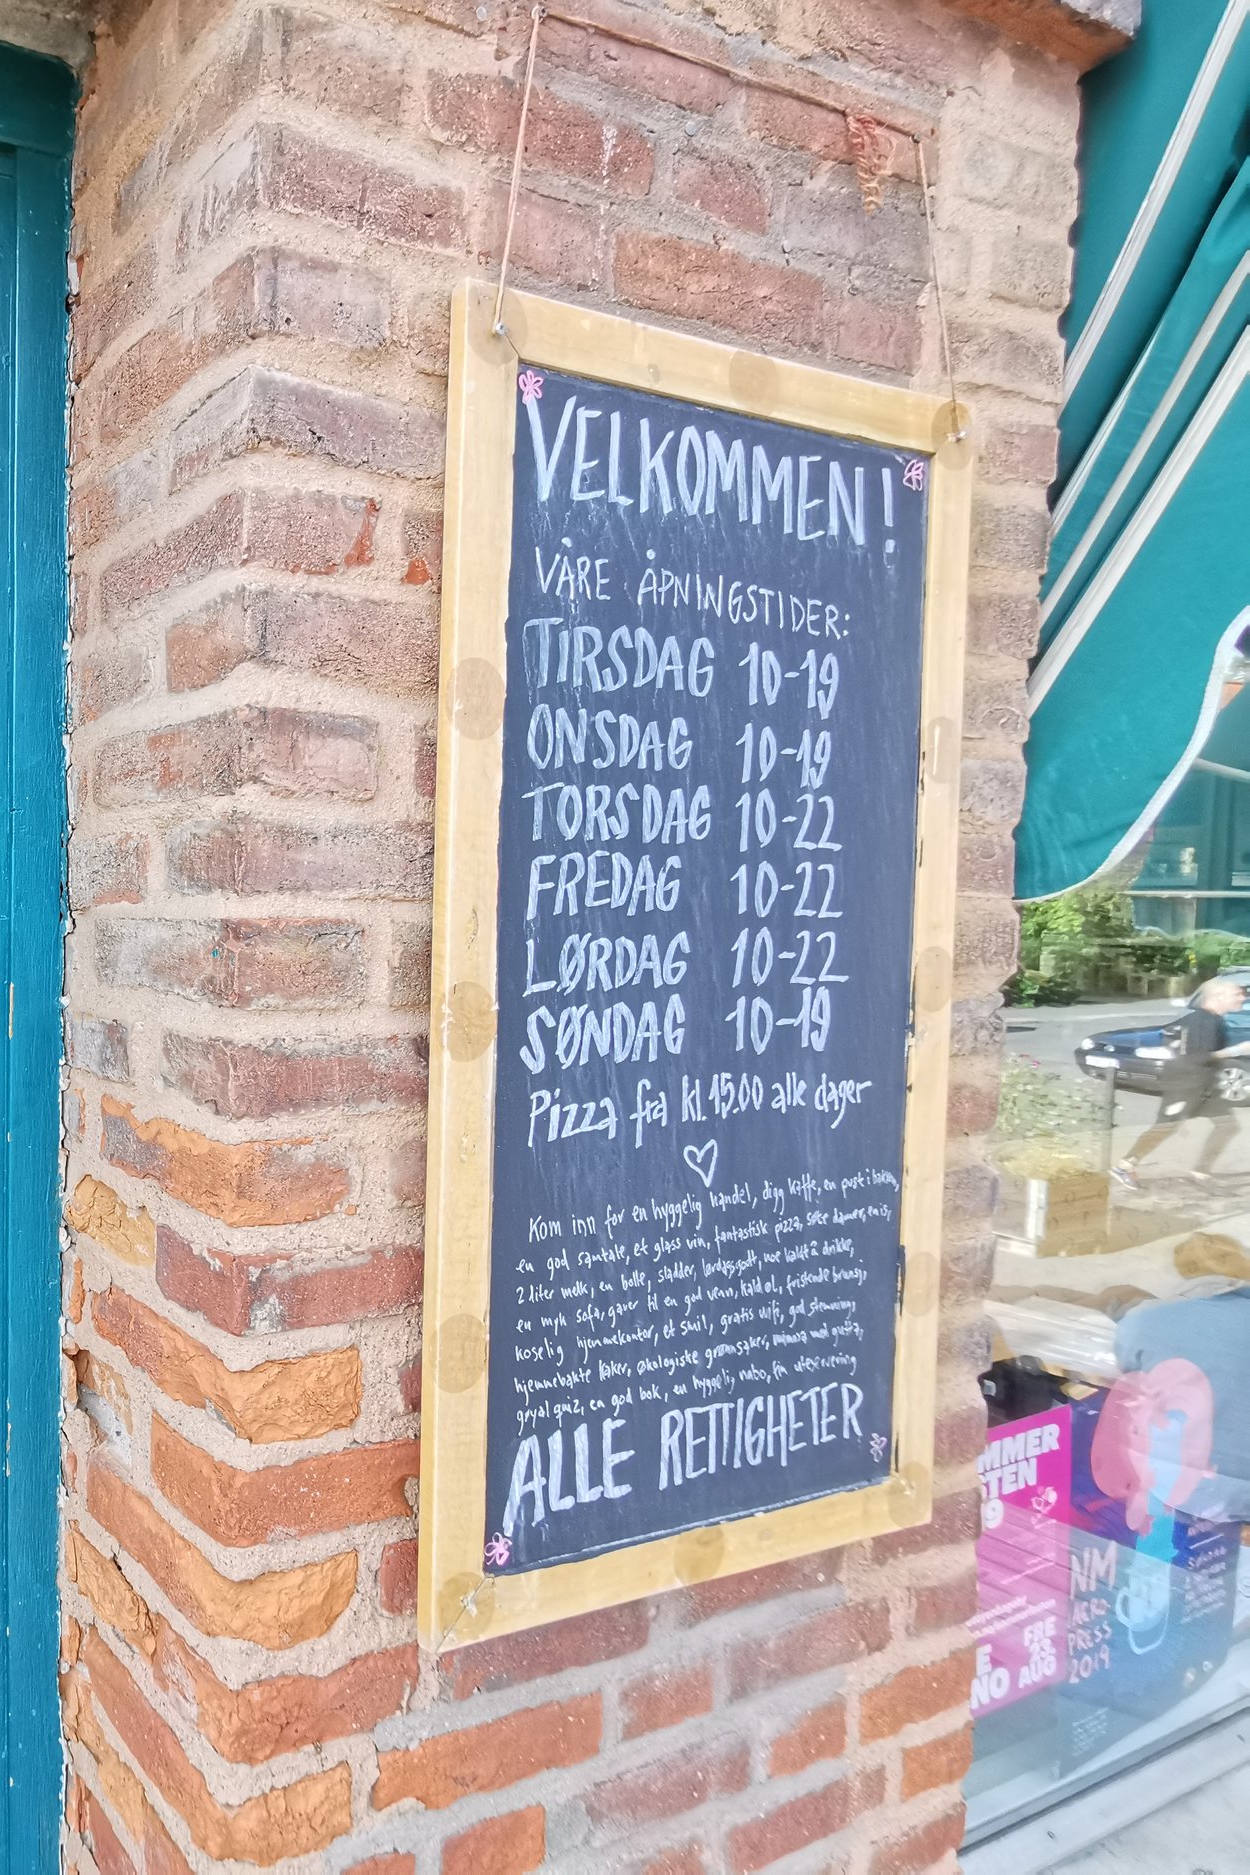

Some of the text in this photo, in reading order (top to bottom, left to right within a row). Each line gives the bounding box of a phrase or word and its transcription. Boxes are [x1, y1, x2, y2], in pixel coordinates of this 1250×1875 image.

[535, 537, 851, 640] VÅRE ÅPNINGSTIDER:
[524, 618, 840, 720] TIRSDAG 10-19
[527, 703, 831, 789] ONSDAG 10-19
[522, 782, 842, 852] TORSDAG 10-22
[527, 850, 843, 921] FREDAG 10-22
[523, 926, 849, 997] LØRDAG 10-22
[519, 986, 831, 1074] SØNDAG 10-19
[528, 1090, 618, 1147] Pizza
[629, 1079, 668, 1149] fra
[771, 1072, 806, 1113] alle
[814, 1073, 872, 1129] dager
[529, 1215, 561, 1243] Kom
[572, 1214, 596, 1237] inn
[605, 1204, 625, 1240] for
[632, 1205, 648, 1222] en
[651, 1192, 702, 1232] hyggelig
[762, 1180, 785, 1215] digg
[516, 1259, 534, 1273] en
[547, 1248, 570, 1281] god
[634, 1238, 648, 1257] et
[653, 1237, 681, 1262] glass
[714, 1219, 768, 1255] fantastisk
[516, 1286, 525, 1304] 2
[528, 1284, 555, 1303] liter
[599, 1281, 613, 1291] en
[516, 1319, 531, 1333] en
[541, 1312, 567, 1336] myk
[608, 1300, 638, 1328] gaver
[648, 1292, 658, 1312] til
[663, 1297, 678, 1307] en
[685, 1286, 702, 1317] god
[515, 1337, 564, 1367] koselig
[663, 1319, 676, 1339] et
[720, 1308, 755, 1335] gratis
[589, 1399, 605, 1411] en
[611, 1387, 633, 1417] god
[672, 1383, 687, 1395] en
[502, 1382, 864, 1538] ALLE RETTIGHETER
[1070, 1541, 1117, 1599] NM
[1018, 1655, 1057, 1688] AUG
